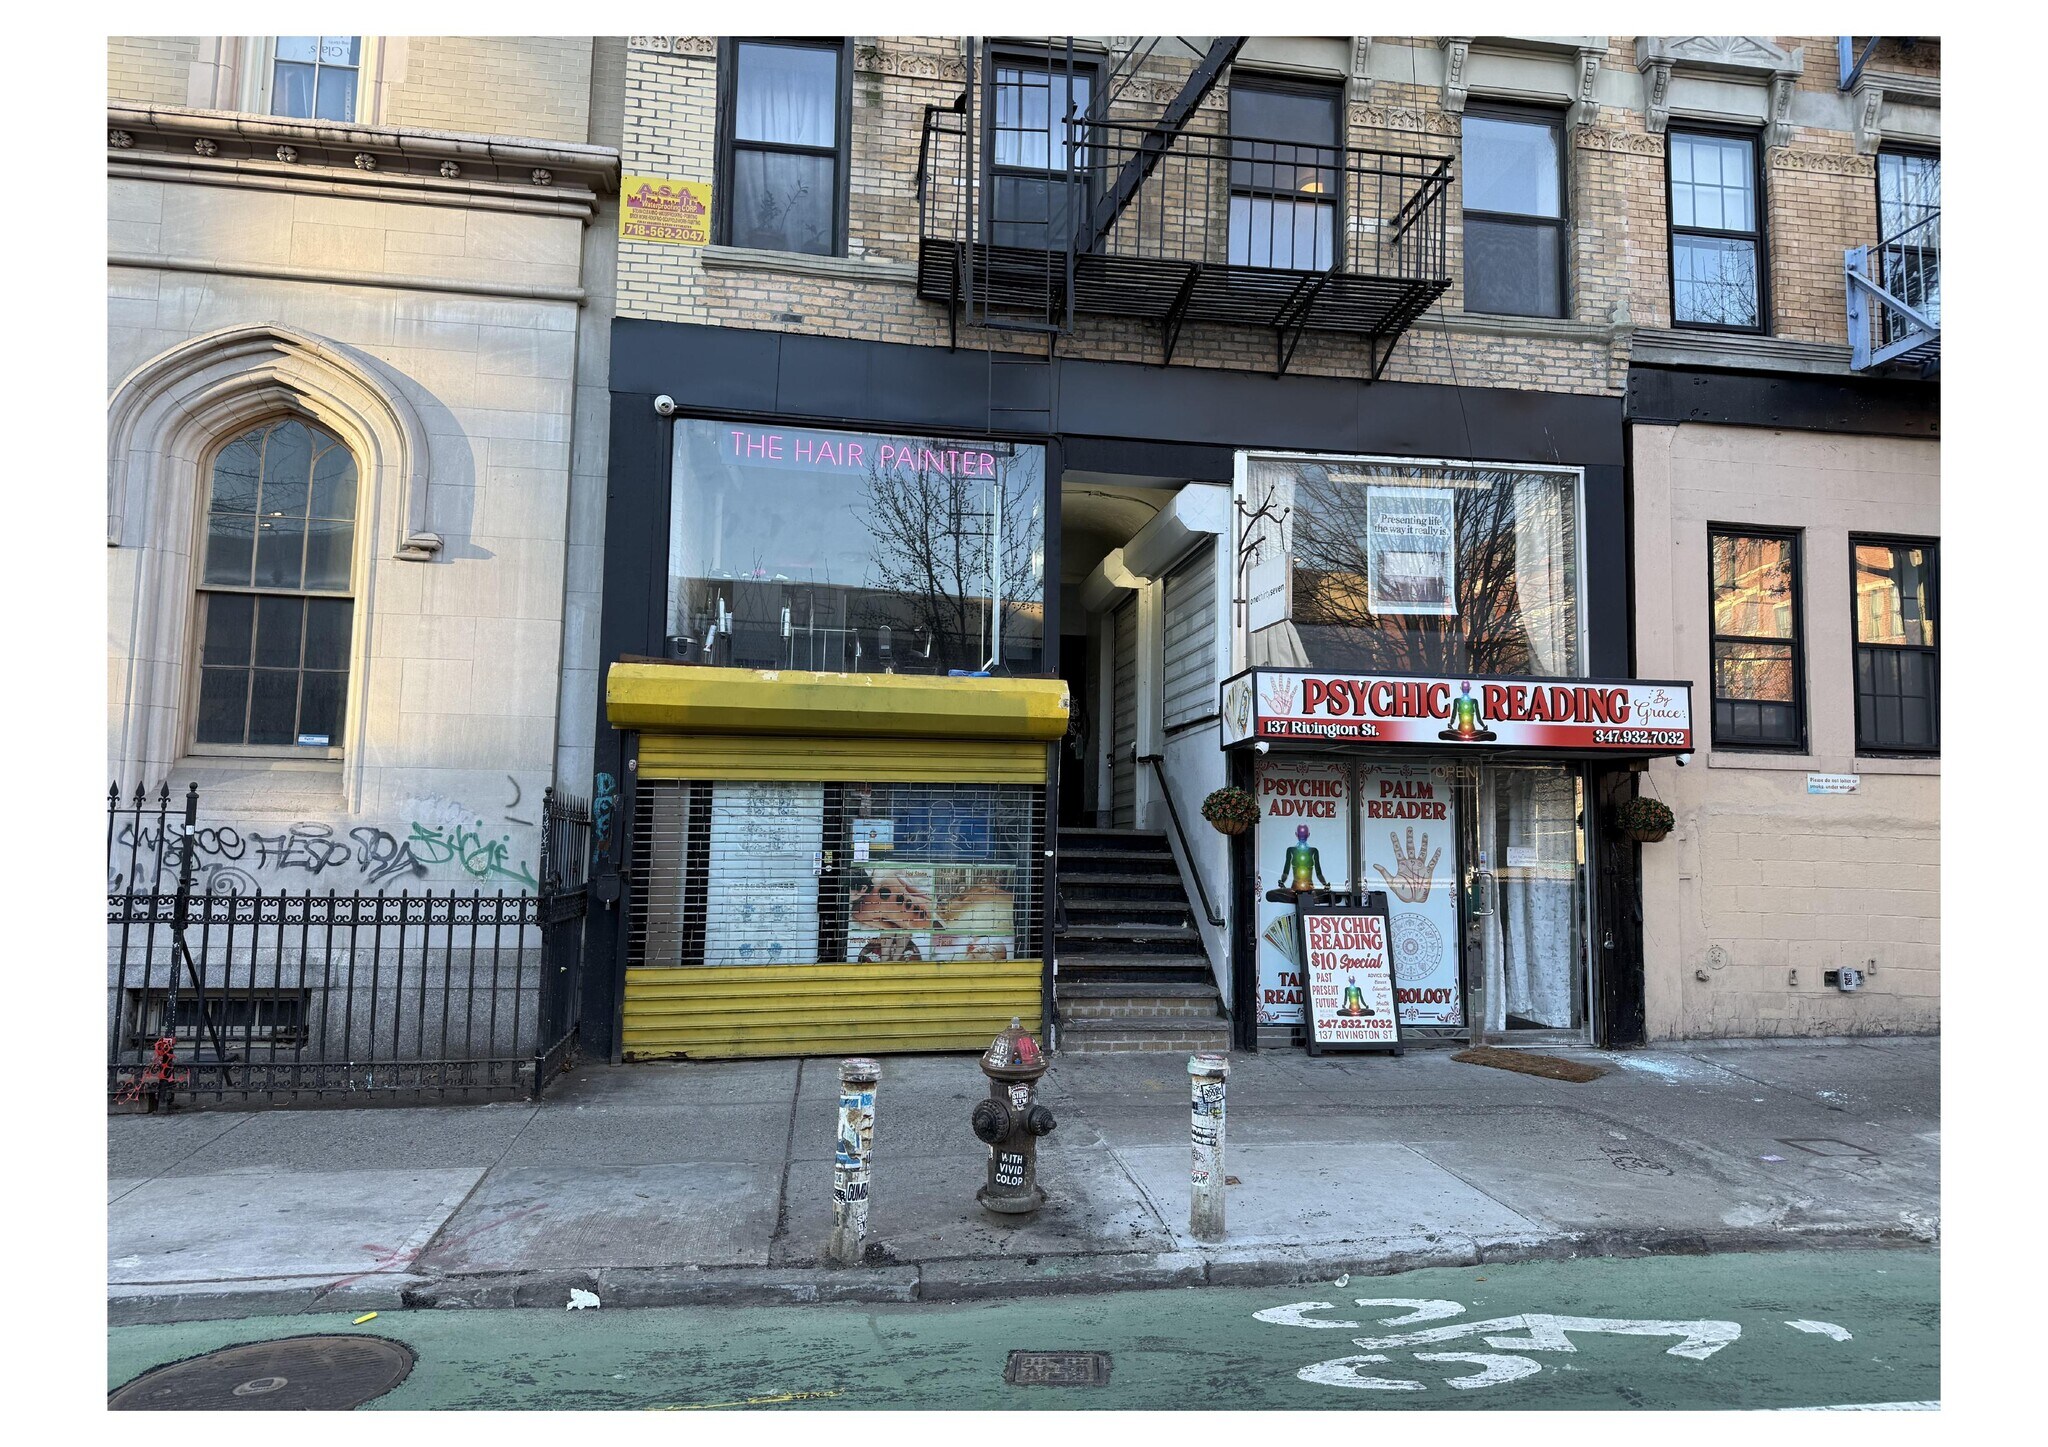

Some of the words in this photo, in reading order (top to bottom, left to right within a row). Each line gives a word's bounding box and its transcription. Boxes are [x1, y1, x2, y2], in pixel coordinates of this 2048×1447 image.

[626, 224, 704, 241] 718-562-2047
[731, 431, 783, 460] THE
[795, 439, 863, 467] HAIR
[880, 445, 995, 476] PAINTER
[1381, 514, 1427, 526] Presenting
[1428, 516, 1442, 526] life
[1374, 524, 1388, 533] the
[1389, 526, 1406, 535] way
[1407, 525, 1413, 534] it
[1414, 525, 1438, 536] really
[1439, 527, 1449, 536] is.
[1302, 678, 1451, 719] PSYCHIC
[1482, 684, 1631, 724] READING
[1653, 689, 1672, 707] By
[1634, 699, 1681, 726] Grace
[1266, 720, 1288, 734] 137
[1291, 721, 1359, 738] Rivington
[1361, 723, 1380, 737] St.
[1595, 729, 1685, 745] 347.932.7032
[1436, 765, 1476, 778] OPEN
[1263, 777, 1343, 798] PSYCHIC
[1380, 780, 1434, 800] PALM
[1269, 799, 1337, 818] ADVICE
[1368, 800, 1447, 820] READER
[1308, 917, 1381, 934] PSYCHIC
[1310, 934, 1383, 950] READING
[1311, 950, 1338, 970] $10
[1339, 953, 1383, 973] Special
[1316, 972, 1332, 983] PAST
[1264, 989, 1304, 1004] READ
[1312, 985, 1339, 996] PRESENT
[1397, 987, 1452, 1004] ROLOGY
[1315, 998, 1338, 1008] FUTURE
[1318, 1019, 1393, 1029] 347.932.7032
[1319, 1030, 1333, 1040] 137
[1336, 1030, 1380, 1040] RIVINGTON
[1383, 1030, 1393, 1040] ST
[1001, 1152, 1023, 1164] WITH
[1000, 1163, 1023, 1175] VIVID
